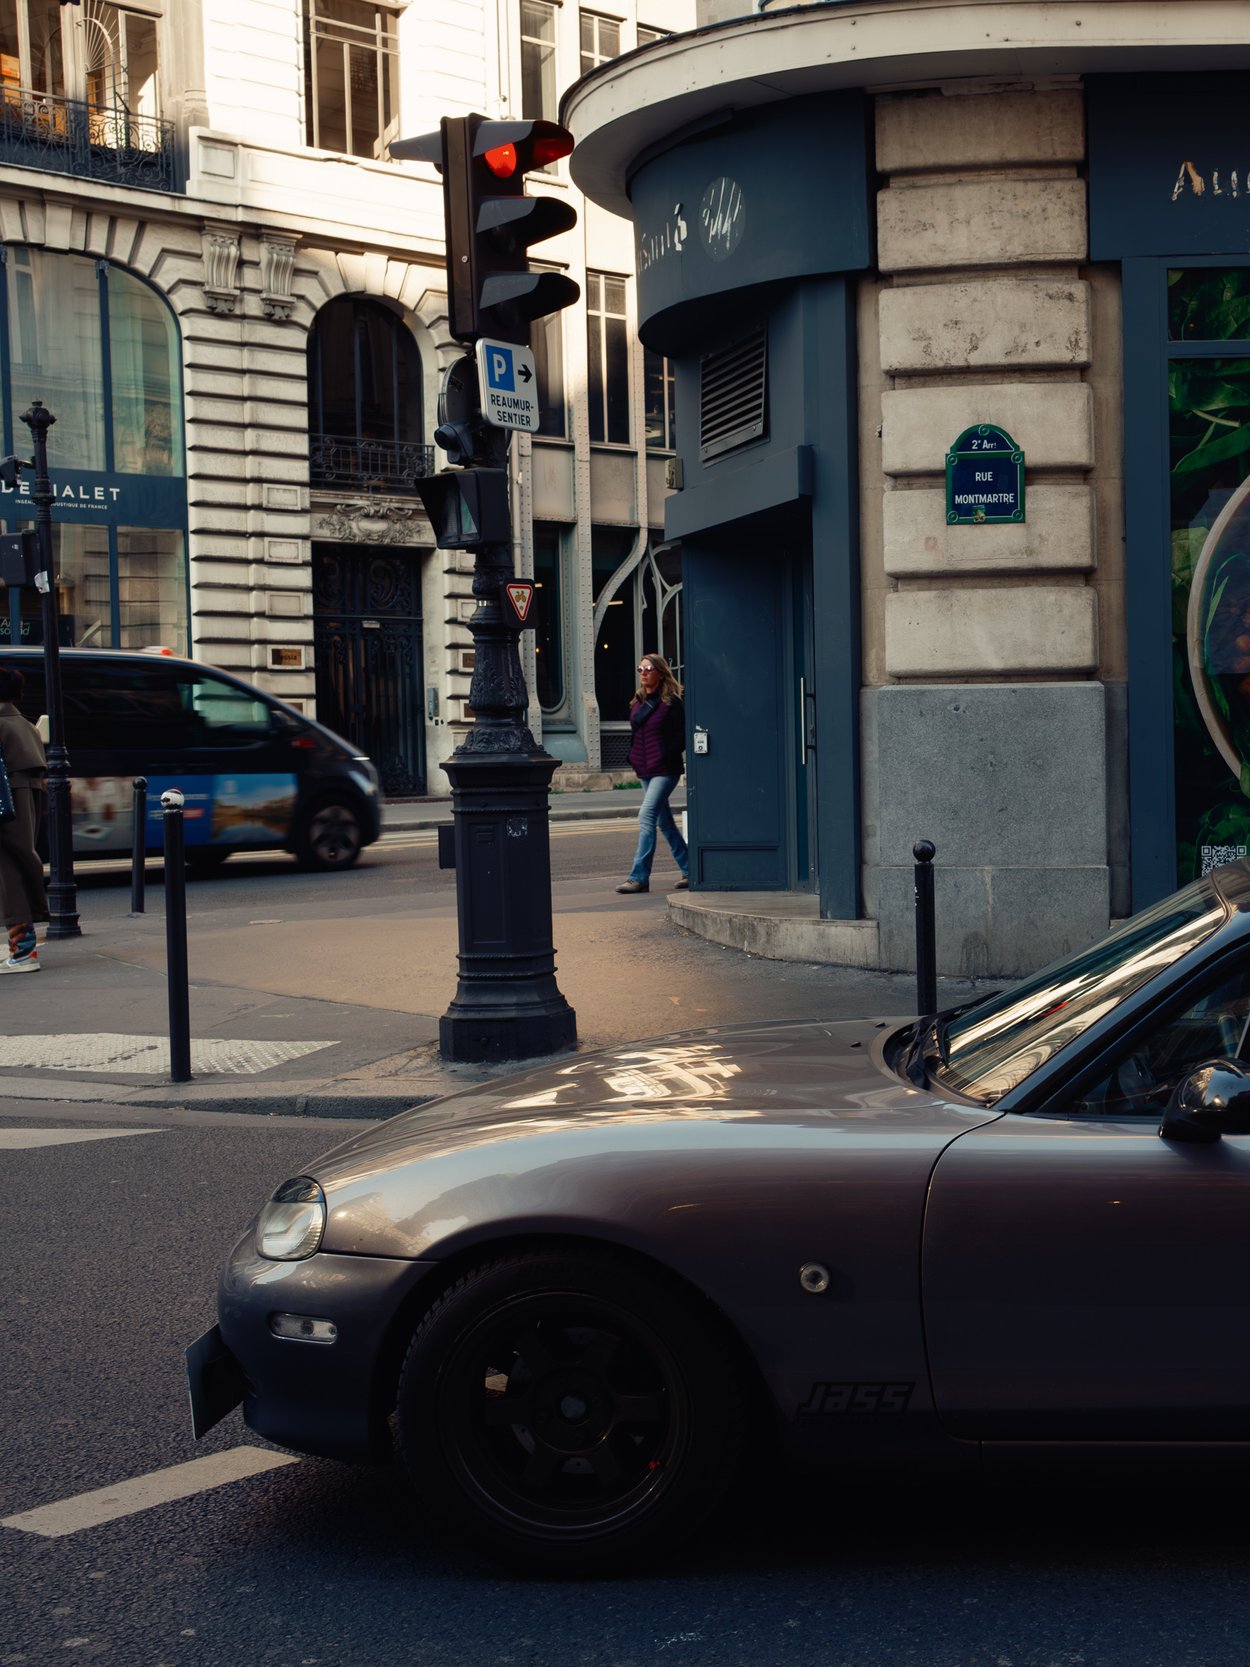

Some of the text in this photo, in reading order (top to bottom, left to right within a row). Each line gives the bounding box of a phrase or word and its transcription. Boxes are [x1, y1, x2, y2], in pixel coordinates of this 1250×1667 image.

[492, 352, 507, 383] P
[490, 394, 534, 412] REAUMUR-
[497, 411, 531, 426] SENTIER
[975, 471, 993, 482] RUE
[954, 493, 1015, 505] MONTMARTRE
[87, 503, 108, 511] FRANCE
